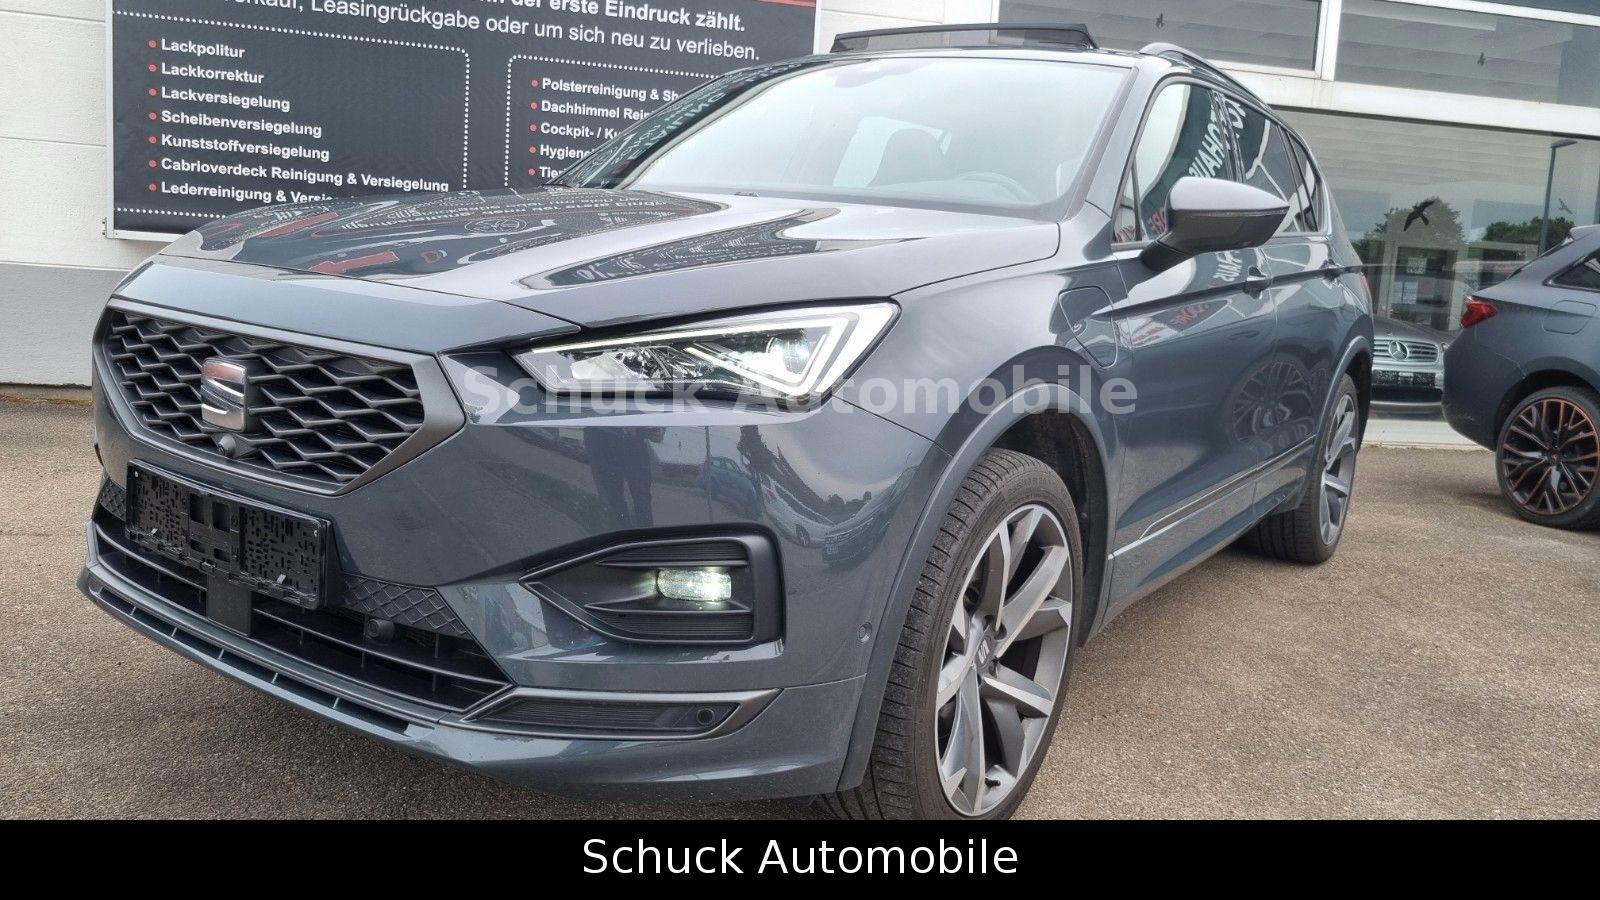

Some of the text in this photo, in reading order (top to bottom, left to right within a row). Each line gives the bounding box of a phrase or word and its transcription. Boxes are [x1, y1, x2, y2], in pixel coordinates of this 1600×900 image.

[549, 0, 599, 14] erste
[605, 0, 690, 25] Eindruck
[695, 11, 745, 31] zählt.
[311, 0, 480, 29] Leasingrückgabe
[485, 16, 529, 34] oder
[534, 22, 563, 39] um
[569, 24, 605, 43] sich
[611, 31, 644, 48] neu
[650, 36, 671, 50] zu
[677, 38, 760, 60] verlieben.
[161, 38, 245, 58] Lackpolitur
[161, 62, 264, 84] Lackkorrektur
[161, 86, 291, 112] Lackversiegelung
[542, 78, 647, 100] Polsterreinigung
[650, 89, 659, 100] &
[541, 100, 620, 118] Dachhimmel
[161, 110, 323, 138] Scheibenversiegelung
[540, 122, 594, 138] Cockpit-
[161, 134, 330, 162] Kunststoffversiegelung
[161, 157, 449, 192] Cabrioverdeck Reinigung & Versiegelung
[161, 181, 272, 203] Lederreinigung
[276, 190, 287, 202] &
